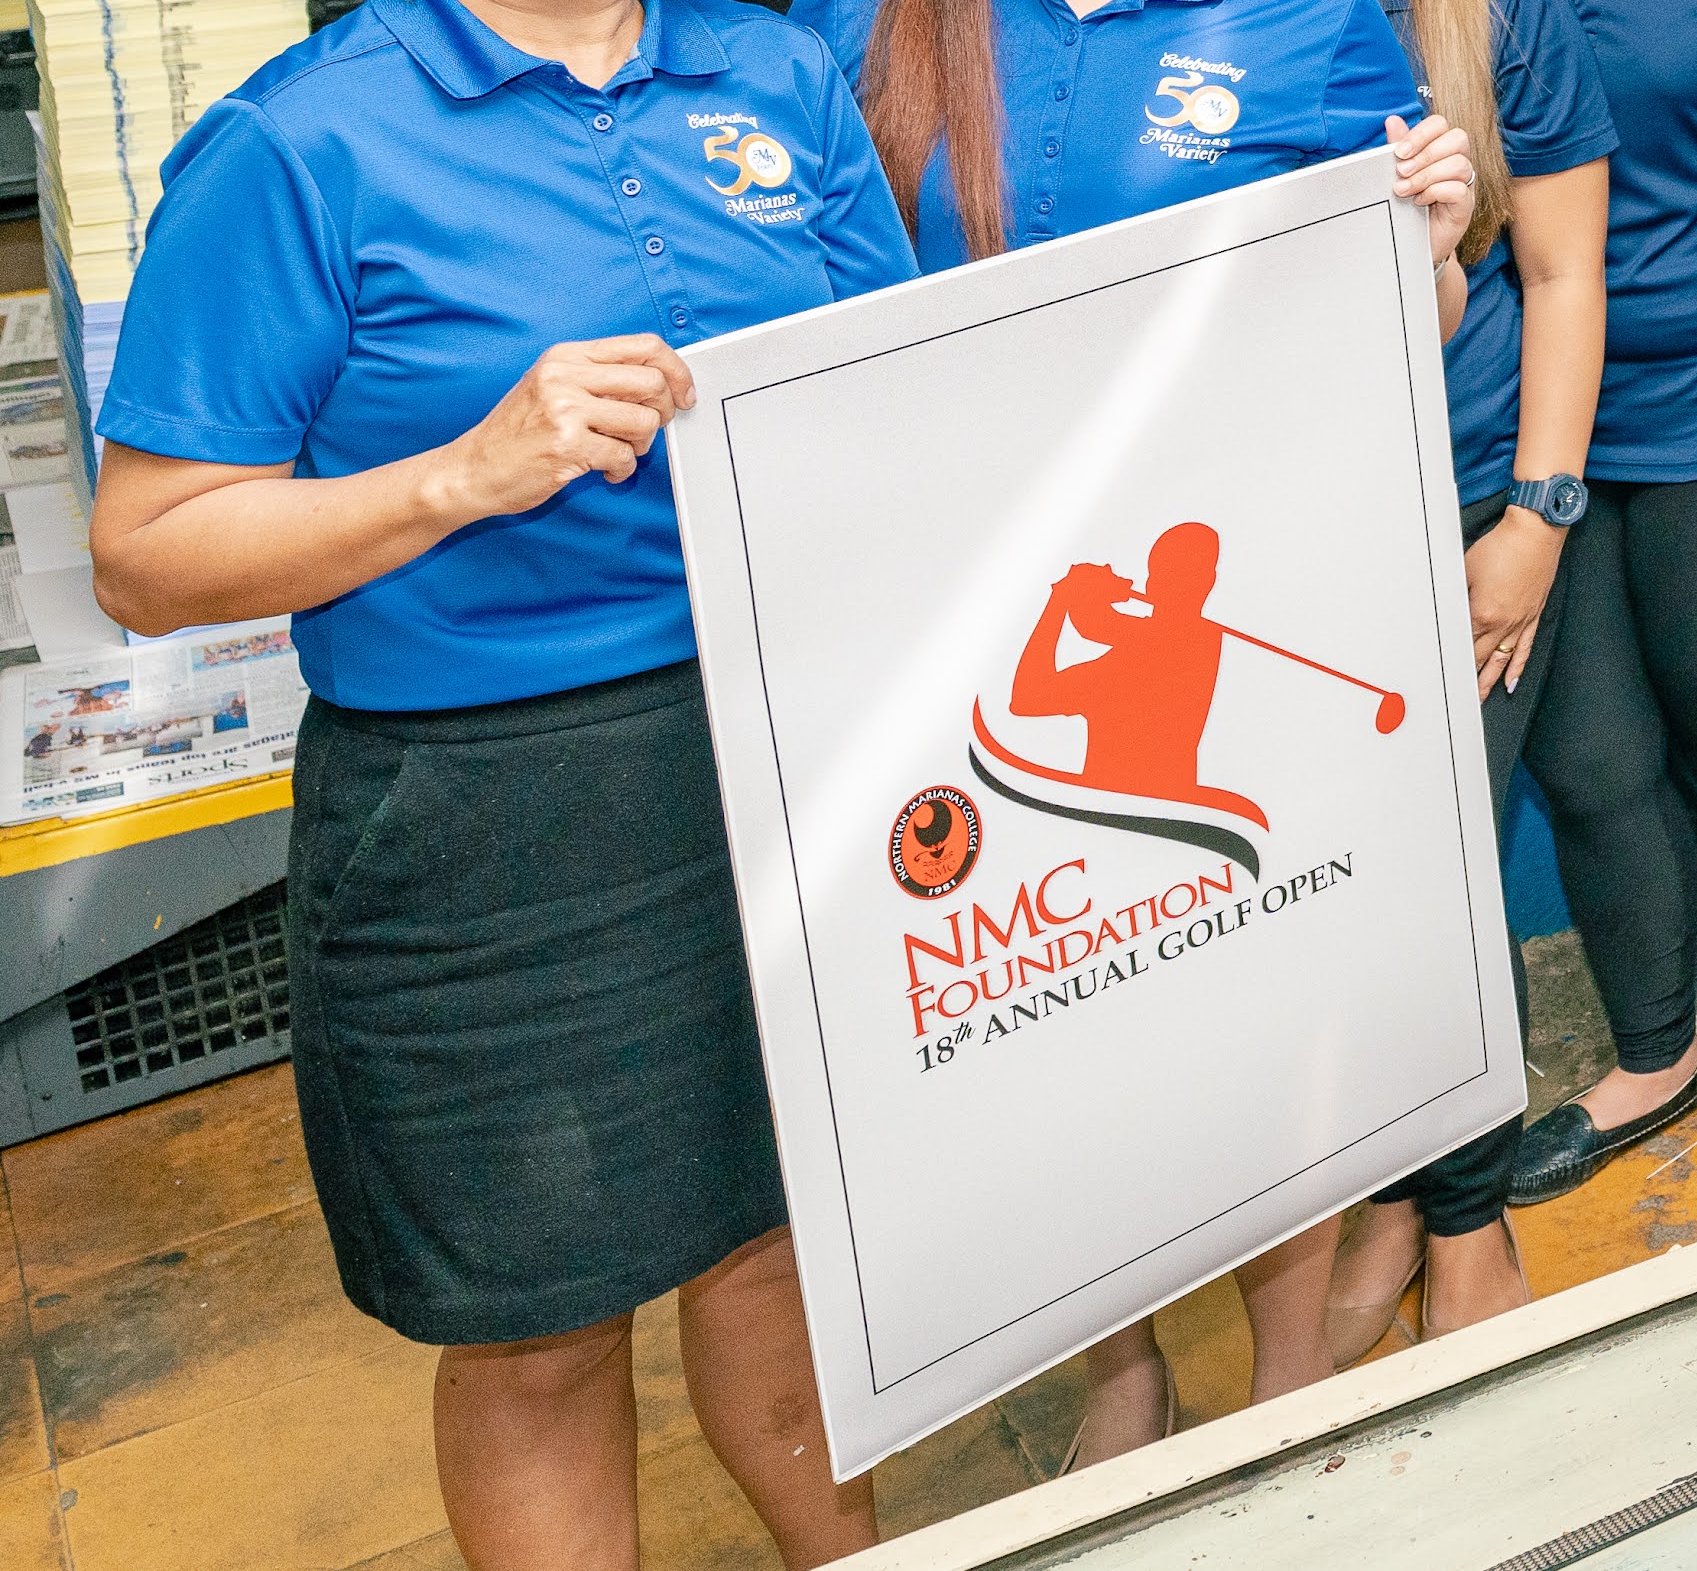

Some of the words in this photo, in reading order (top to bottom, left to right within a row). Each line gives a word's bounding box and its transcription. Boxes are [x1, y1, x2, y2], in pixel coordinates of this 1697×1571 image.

[1159, 52, 1246, 83] Celebrating
[1145, 71, 1240, 135] 50
[703, 125, 792, 196] 50
[1139, 128, 1230, 147] Marianas
[1160, 143, 1227, 164] Variety
[725, 193, 797, 216] Marianas
[747, 207, 805, 225] Variety
[892, 814, 910, 882] NORTHERN
[908, 789, 966, 813] MARIANAS
[962, 805, 978, 852] COLLEGE
[928, 878, 957, 896] 1981
[905, 858, 1092, 992] NMC
[907, 863, 1234, 1039] FOUNDATION
[915, 1020, 976, 1074] 18th
[982, 948, 1150, 1045] ANNUAL
[1157, 899, 1252, 962] GOLF
[1262, 853, 1353, 916] OPEN
